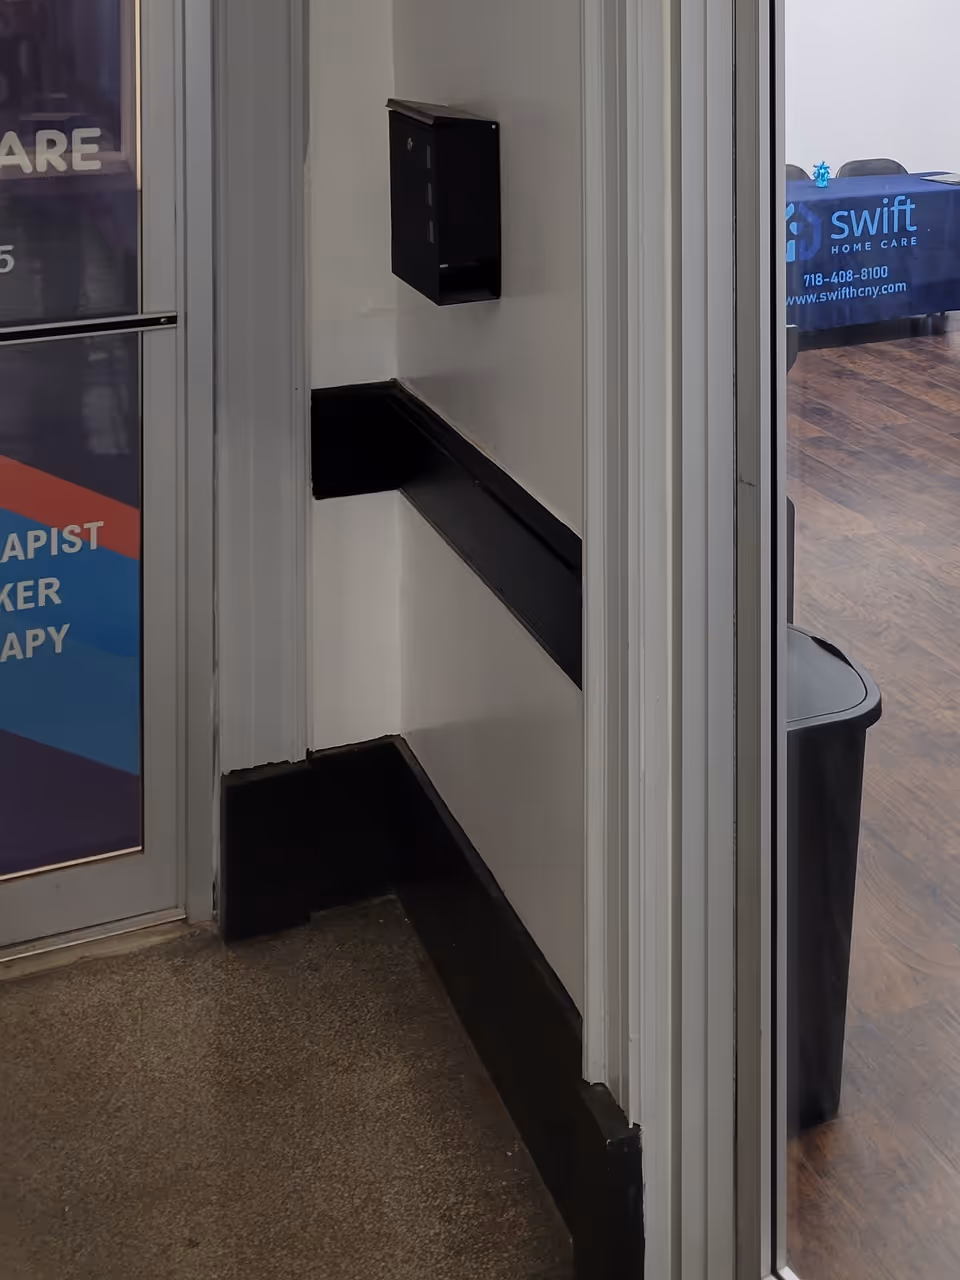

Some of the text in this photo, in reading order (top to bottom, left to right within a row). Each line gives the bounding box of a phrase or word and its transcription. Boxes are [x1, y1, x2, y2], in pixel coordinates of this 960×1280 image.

[0, 127, 102, 173] ARE
[830, 195, 917, 240] swift
[831, 236, 917, 254] HOME CARE
[803, 266, 888, 287] 718-408-8100
[0, 521, 104, 563] APIST
[0, 623, 71, 662] APY
